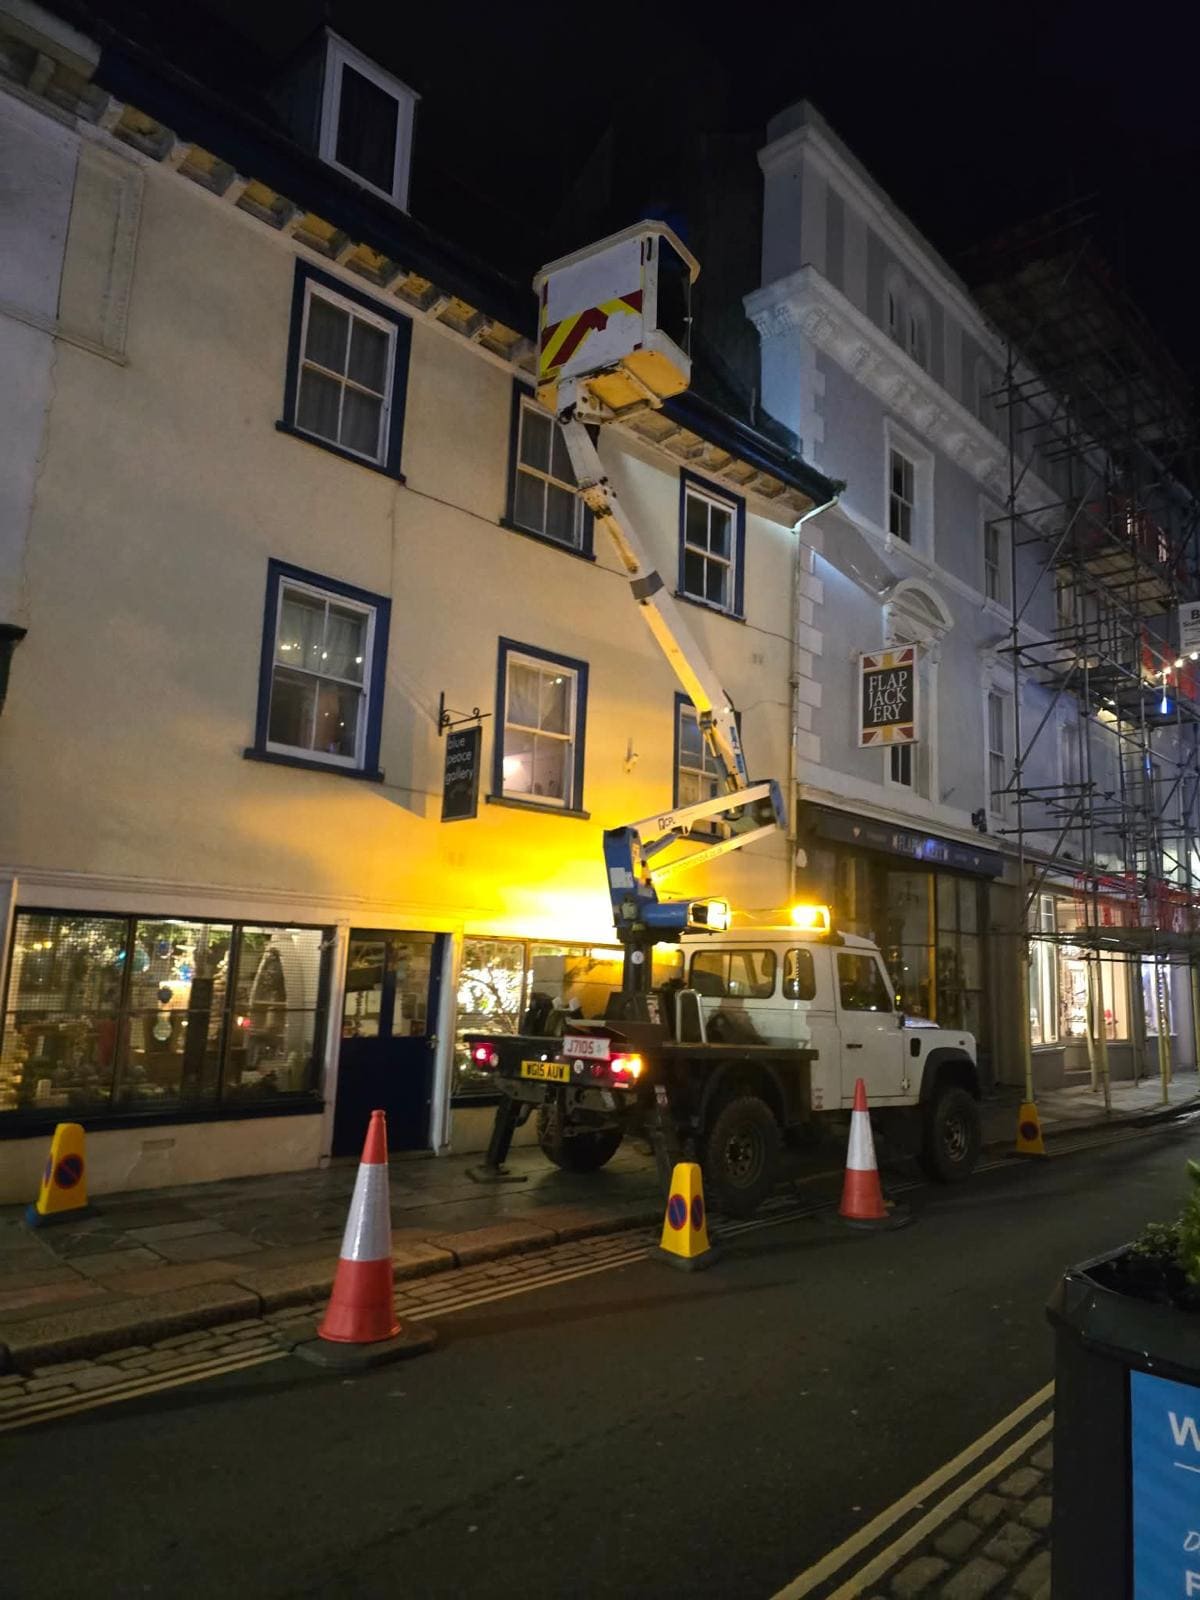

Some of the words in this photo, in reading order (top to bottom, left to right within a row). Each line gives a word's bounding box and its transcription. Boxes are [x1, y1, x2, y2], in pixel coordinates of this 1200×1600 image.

[869, 670, 907, 692] FLAP
[868, 686, 907, 711] JACK
[872, 702, 903, 723] ERY
[447, 751, 473, 765] peace
